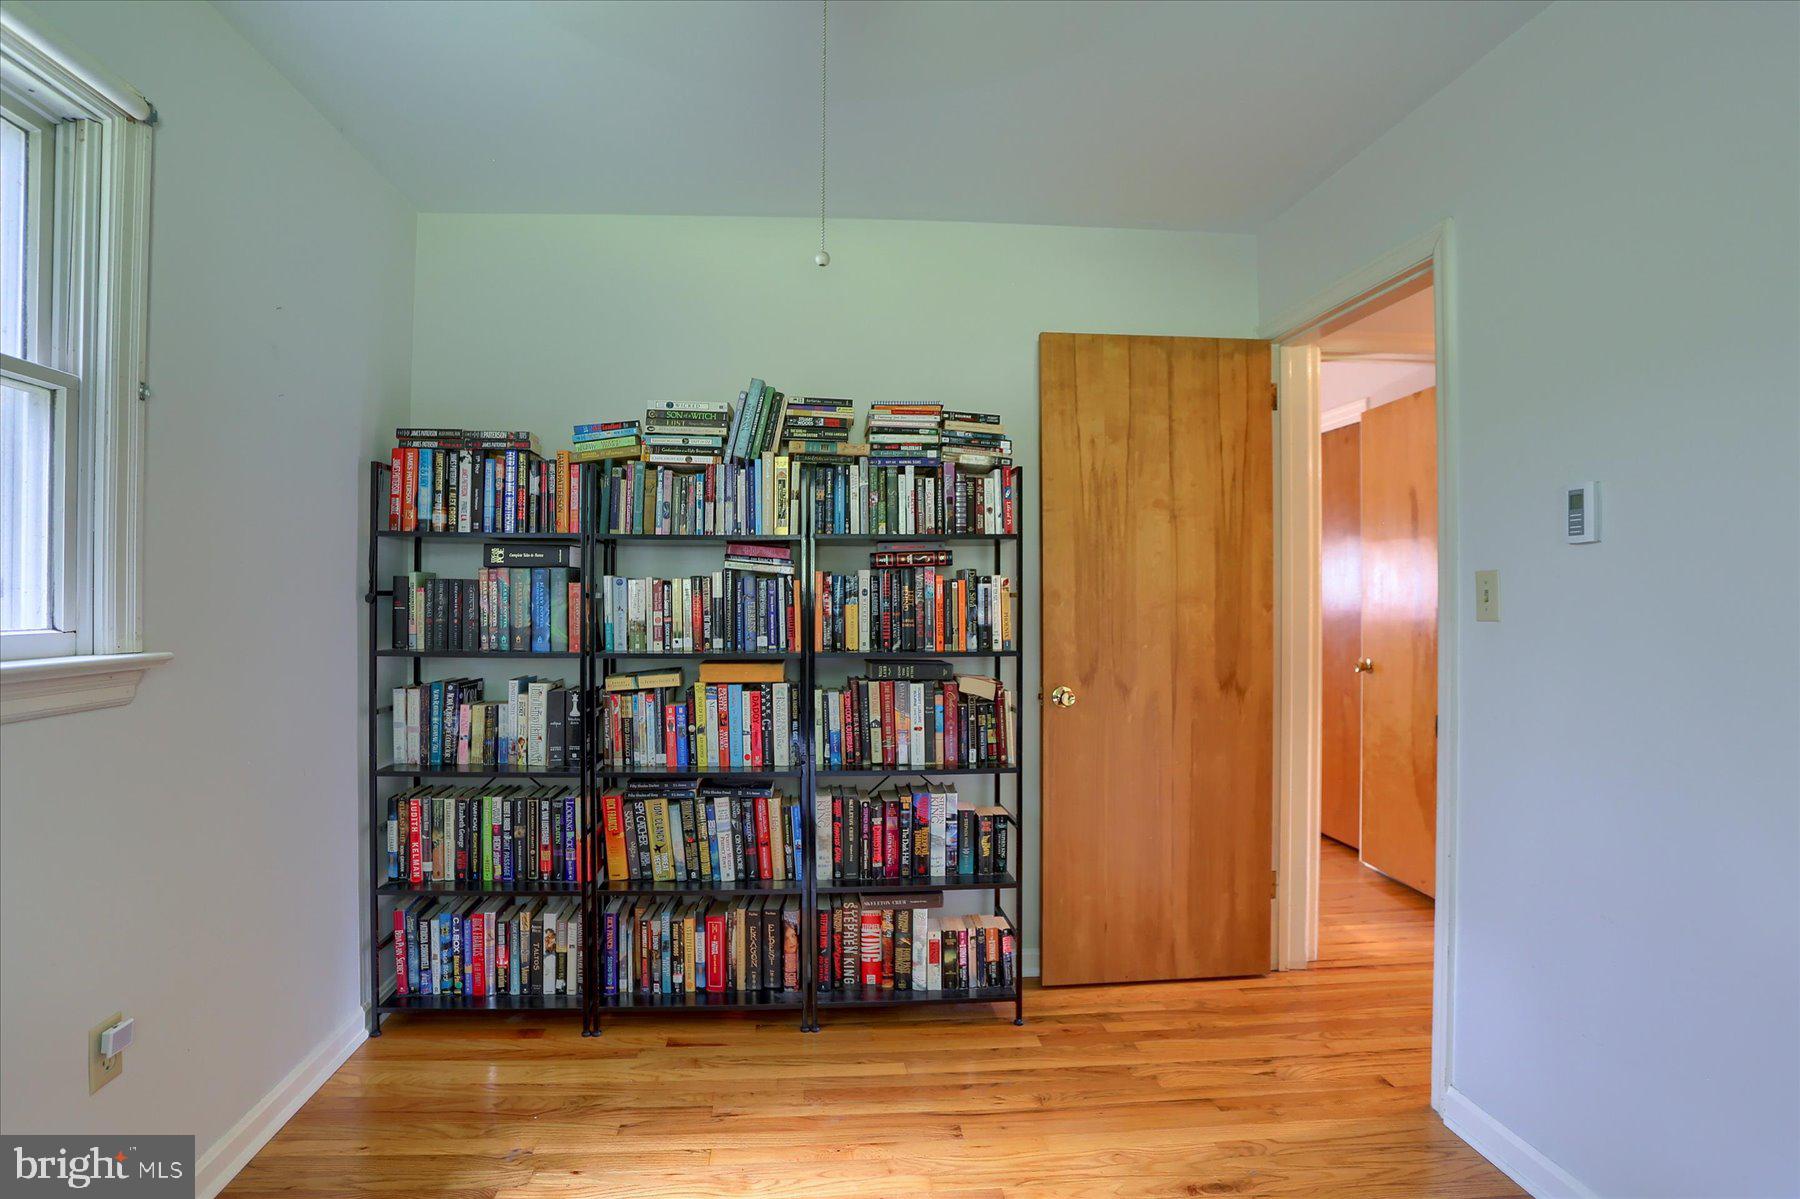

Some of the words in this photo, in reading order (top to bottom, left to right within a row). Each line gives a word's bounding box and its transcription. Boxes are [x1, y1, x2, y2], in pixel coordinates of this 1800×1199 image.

[691, 412, 717, 420] WITCH
[406, 452, 414, 470] JAMES
[406, 471, 414, 504] PATTERSON
[411, 802, 420, 832] JUDITH
[566, 802, 574, 831] LOOKING
[606, 799, 614, 810] DICK
[635, 801, 643, 814] SPY
[817, 800, 826, 828] KING
[930, 796, 938, 824] KING
[608, 810, 617, 831] FRANCIS
[636, 814, 648, 846] CATCHER
[655, 819, 664, 842] CLANCY
[457, 829, 466, 848] George
[872, 825, 882, 863] CHRISTINE
[902, 828, 910, 839] The
[902, 839, 910, 852] Dark
[914, 830, 922, 856] THINGS
[920, 827, 930, 857] NEEDFUL
[412, 842, 420, 878] KELMAN
[736, 845, 742, 854] NO
[902, 852, 910, 865] Half
[503, 852, 511, 876] PASSAGE
[473, 918, 483, 931] DICK
[820, 914, 828, 939] STEPHEN
[843, 902, 856, 953] STEPHEN
[473, 932, 483, 956] FRANCIS
[750, 926, 758, 968] ERAGON
[768, 924, 776, 966] ELDEST
[861, 929, 882, 963] KING
[843, 958, 856, 984] KING
